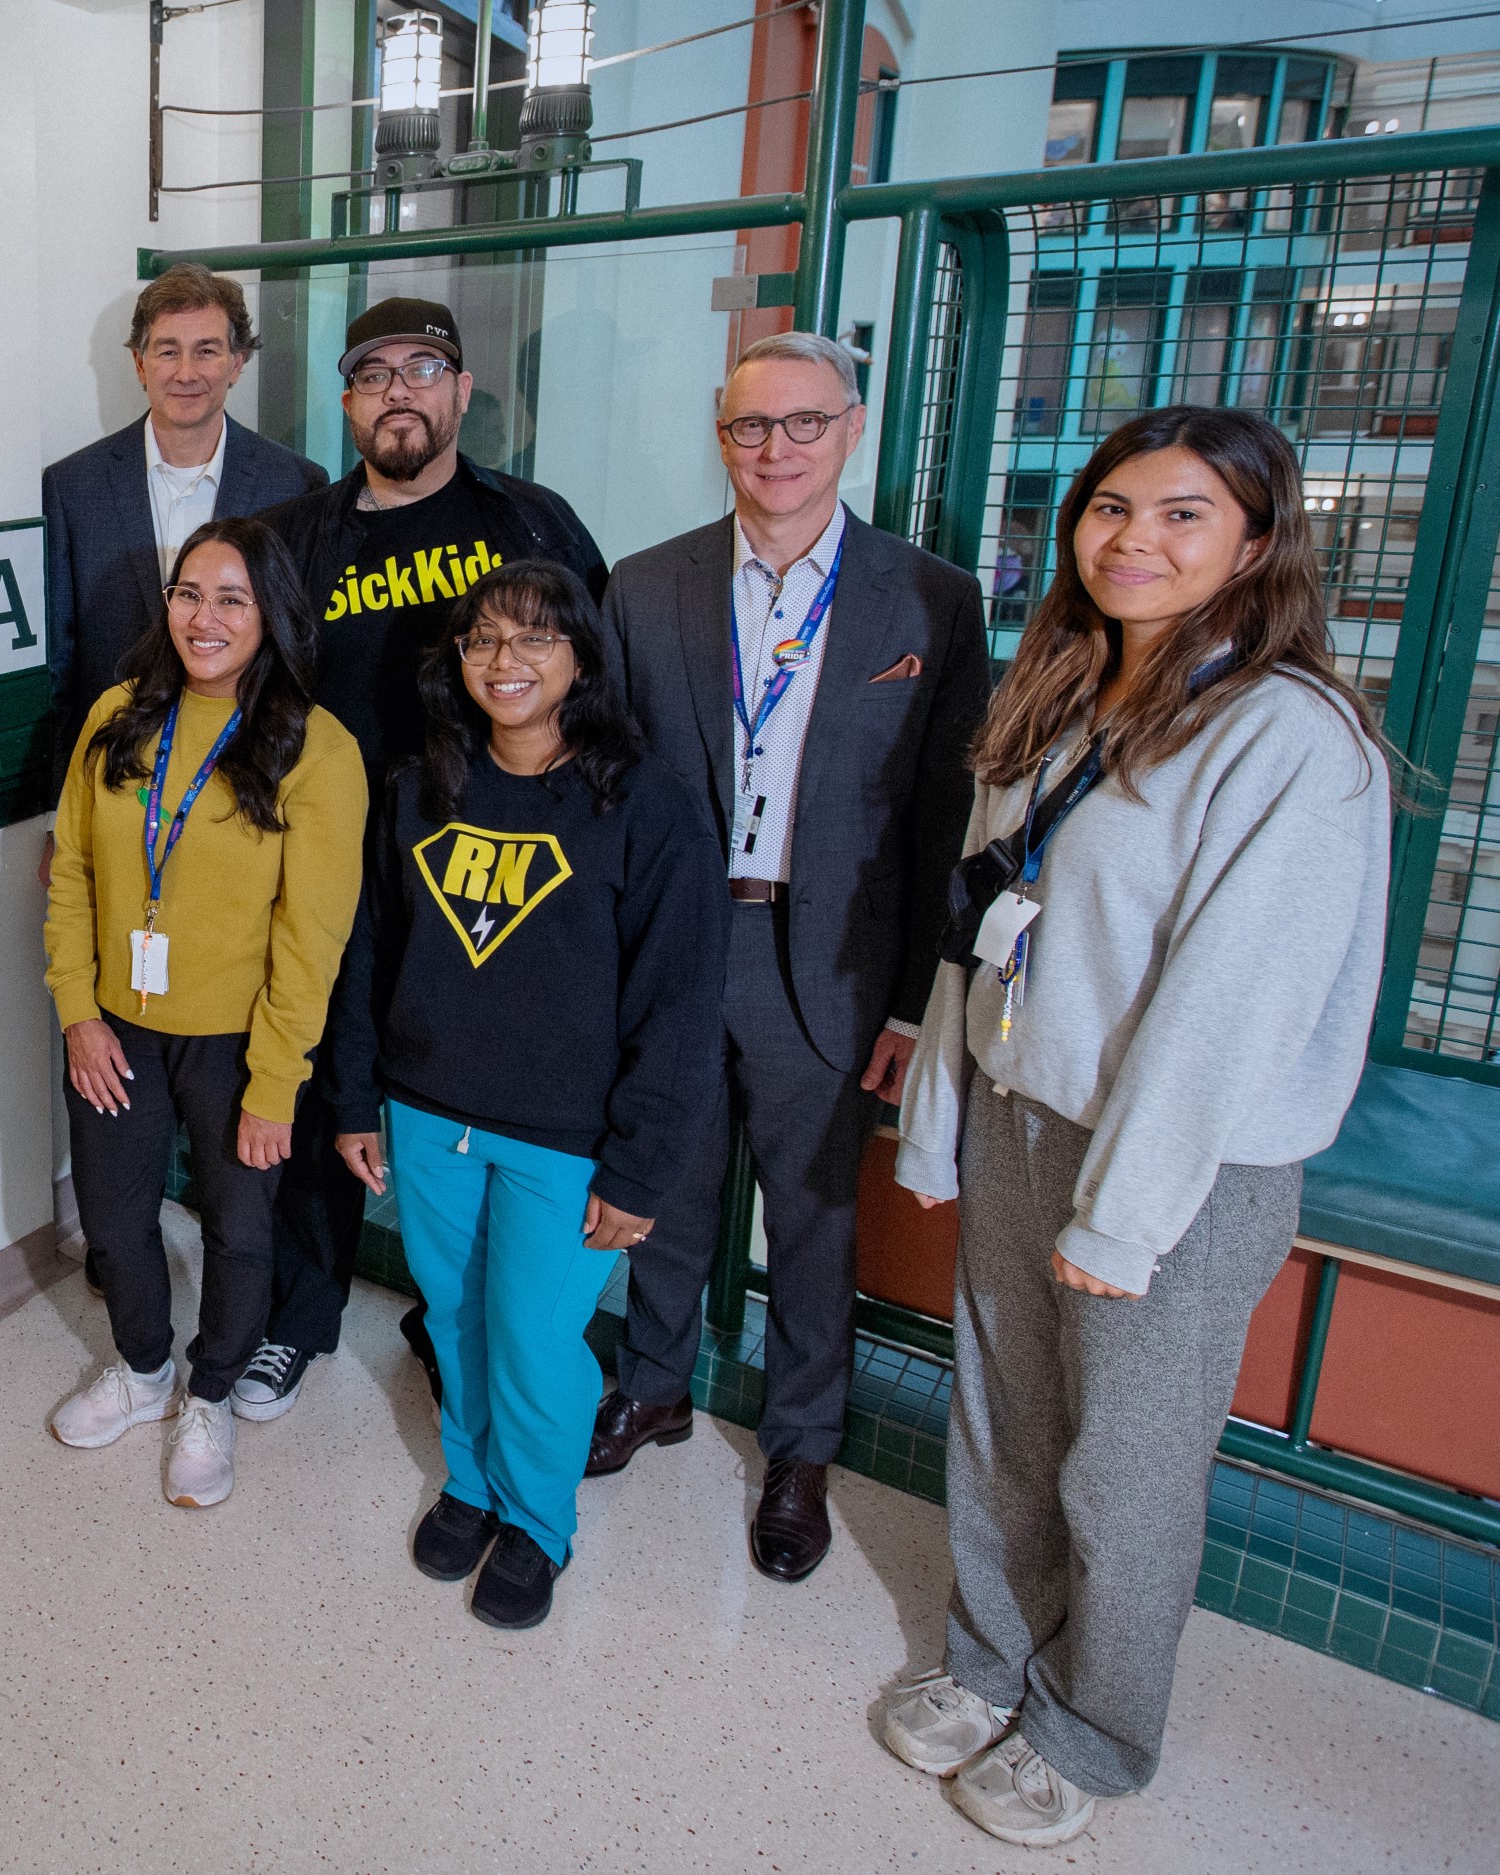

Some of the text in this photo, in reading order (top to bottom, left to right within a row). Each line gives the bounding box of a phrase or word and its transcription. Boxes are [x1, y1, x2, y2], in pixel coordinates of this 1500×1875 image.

[324, 541, 503, 621] SickKid
[818, 579, 834, 604] Diagnose
[779, 652, 804, 660] PRIDE
[1066, 775, 1088, 804] SickKids
[442, 833, 537, 906] RN
